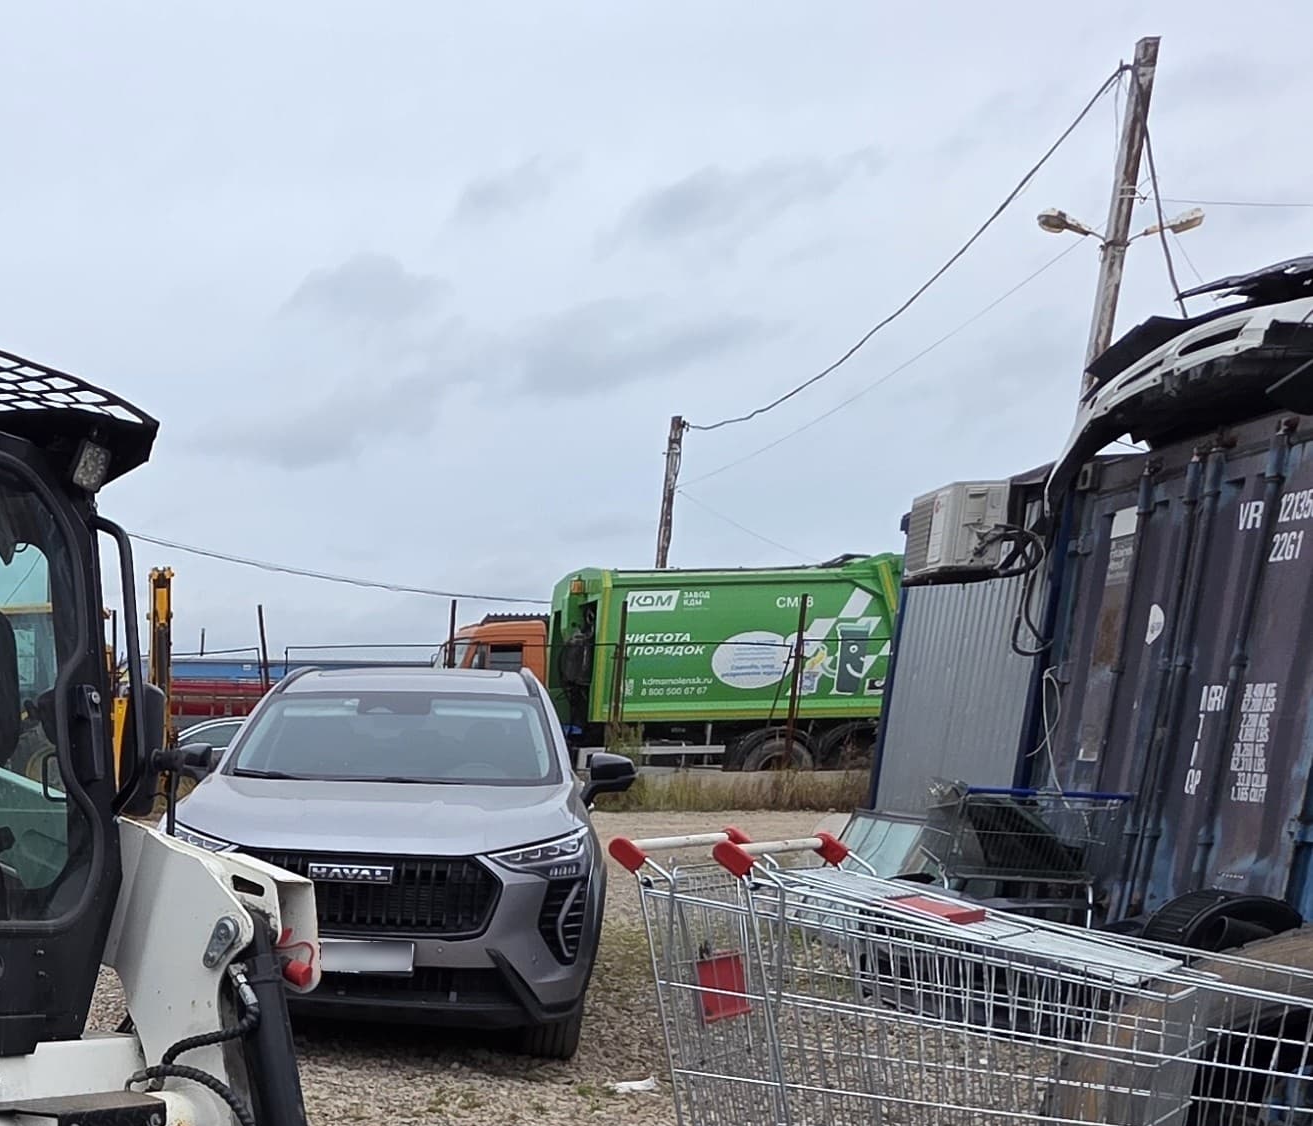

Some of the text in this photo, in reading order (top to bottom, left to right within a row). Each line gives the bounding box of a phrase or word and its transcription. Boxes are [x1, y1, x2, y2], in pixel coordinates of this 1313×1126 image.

[1278, 489, 1313, 523] 12135
[1269, 530, 1304, 562] 22G1
[683, 591, 710, 599] ЗАВОД
[626, 633, 691, 643] ЧИСТОТА
[633, 645, 705, 656] ПОРЯДОК
[311, 867, 389, 880] HAVAL
